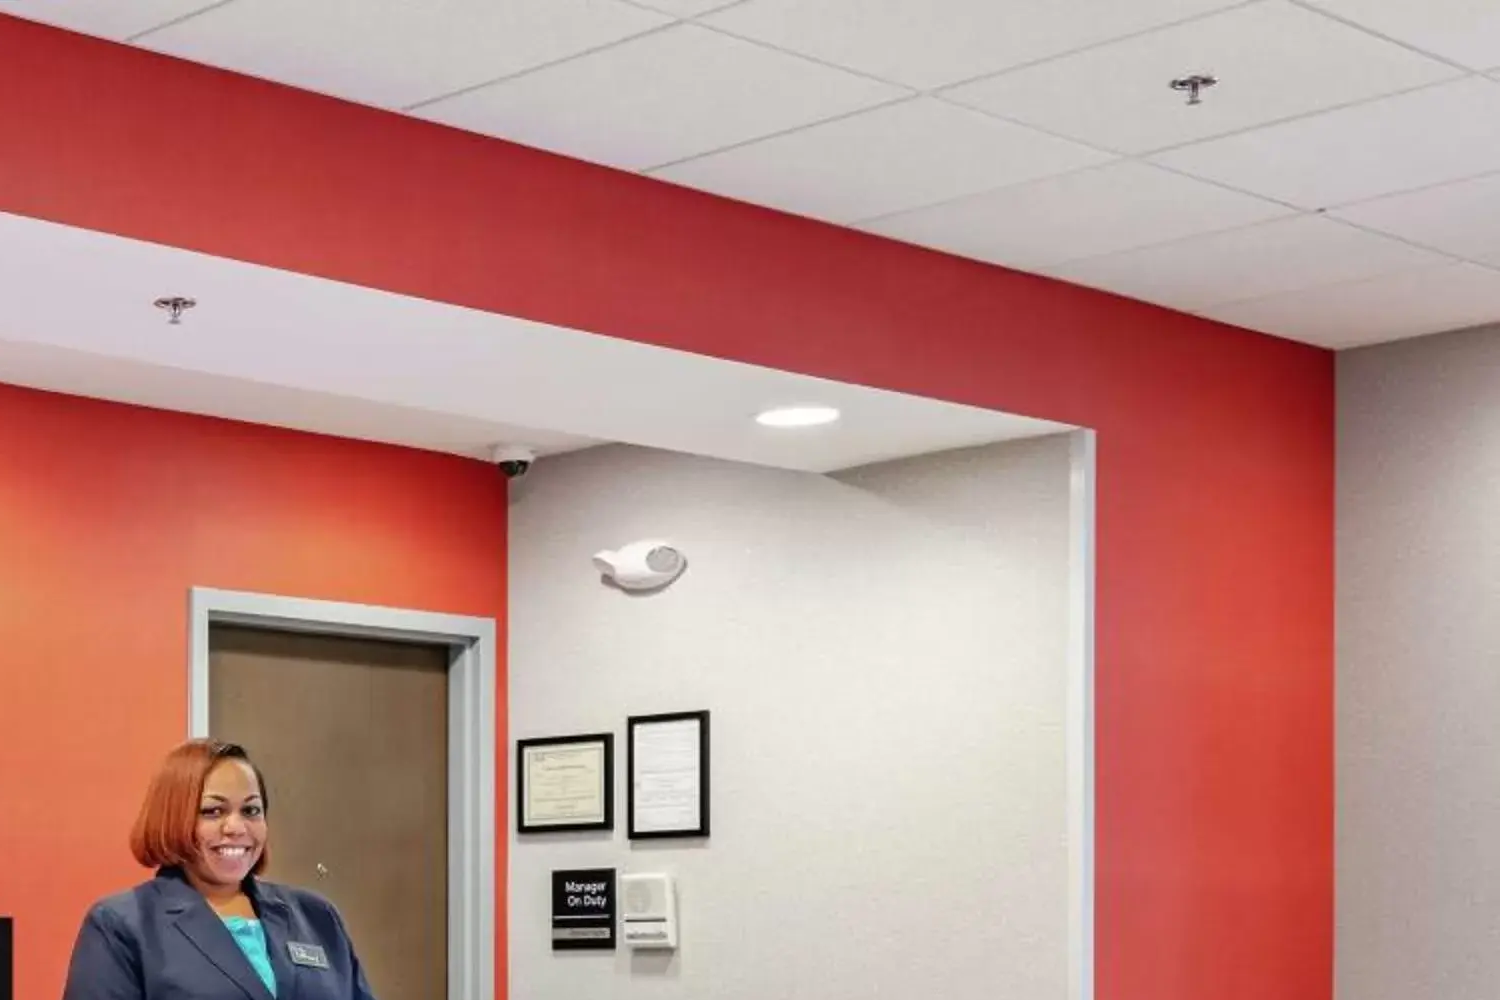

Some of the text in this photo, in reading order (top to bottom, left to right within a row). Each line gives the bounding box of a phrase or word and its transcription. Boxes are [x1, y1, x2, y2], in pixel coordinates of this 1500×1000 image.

[565, 881, 607, 894] Manager
[567, 895, 607, 908] On Duty
